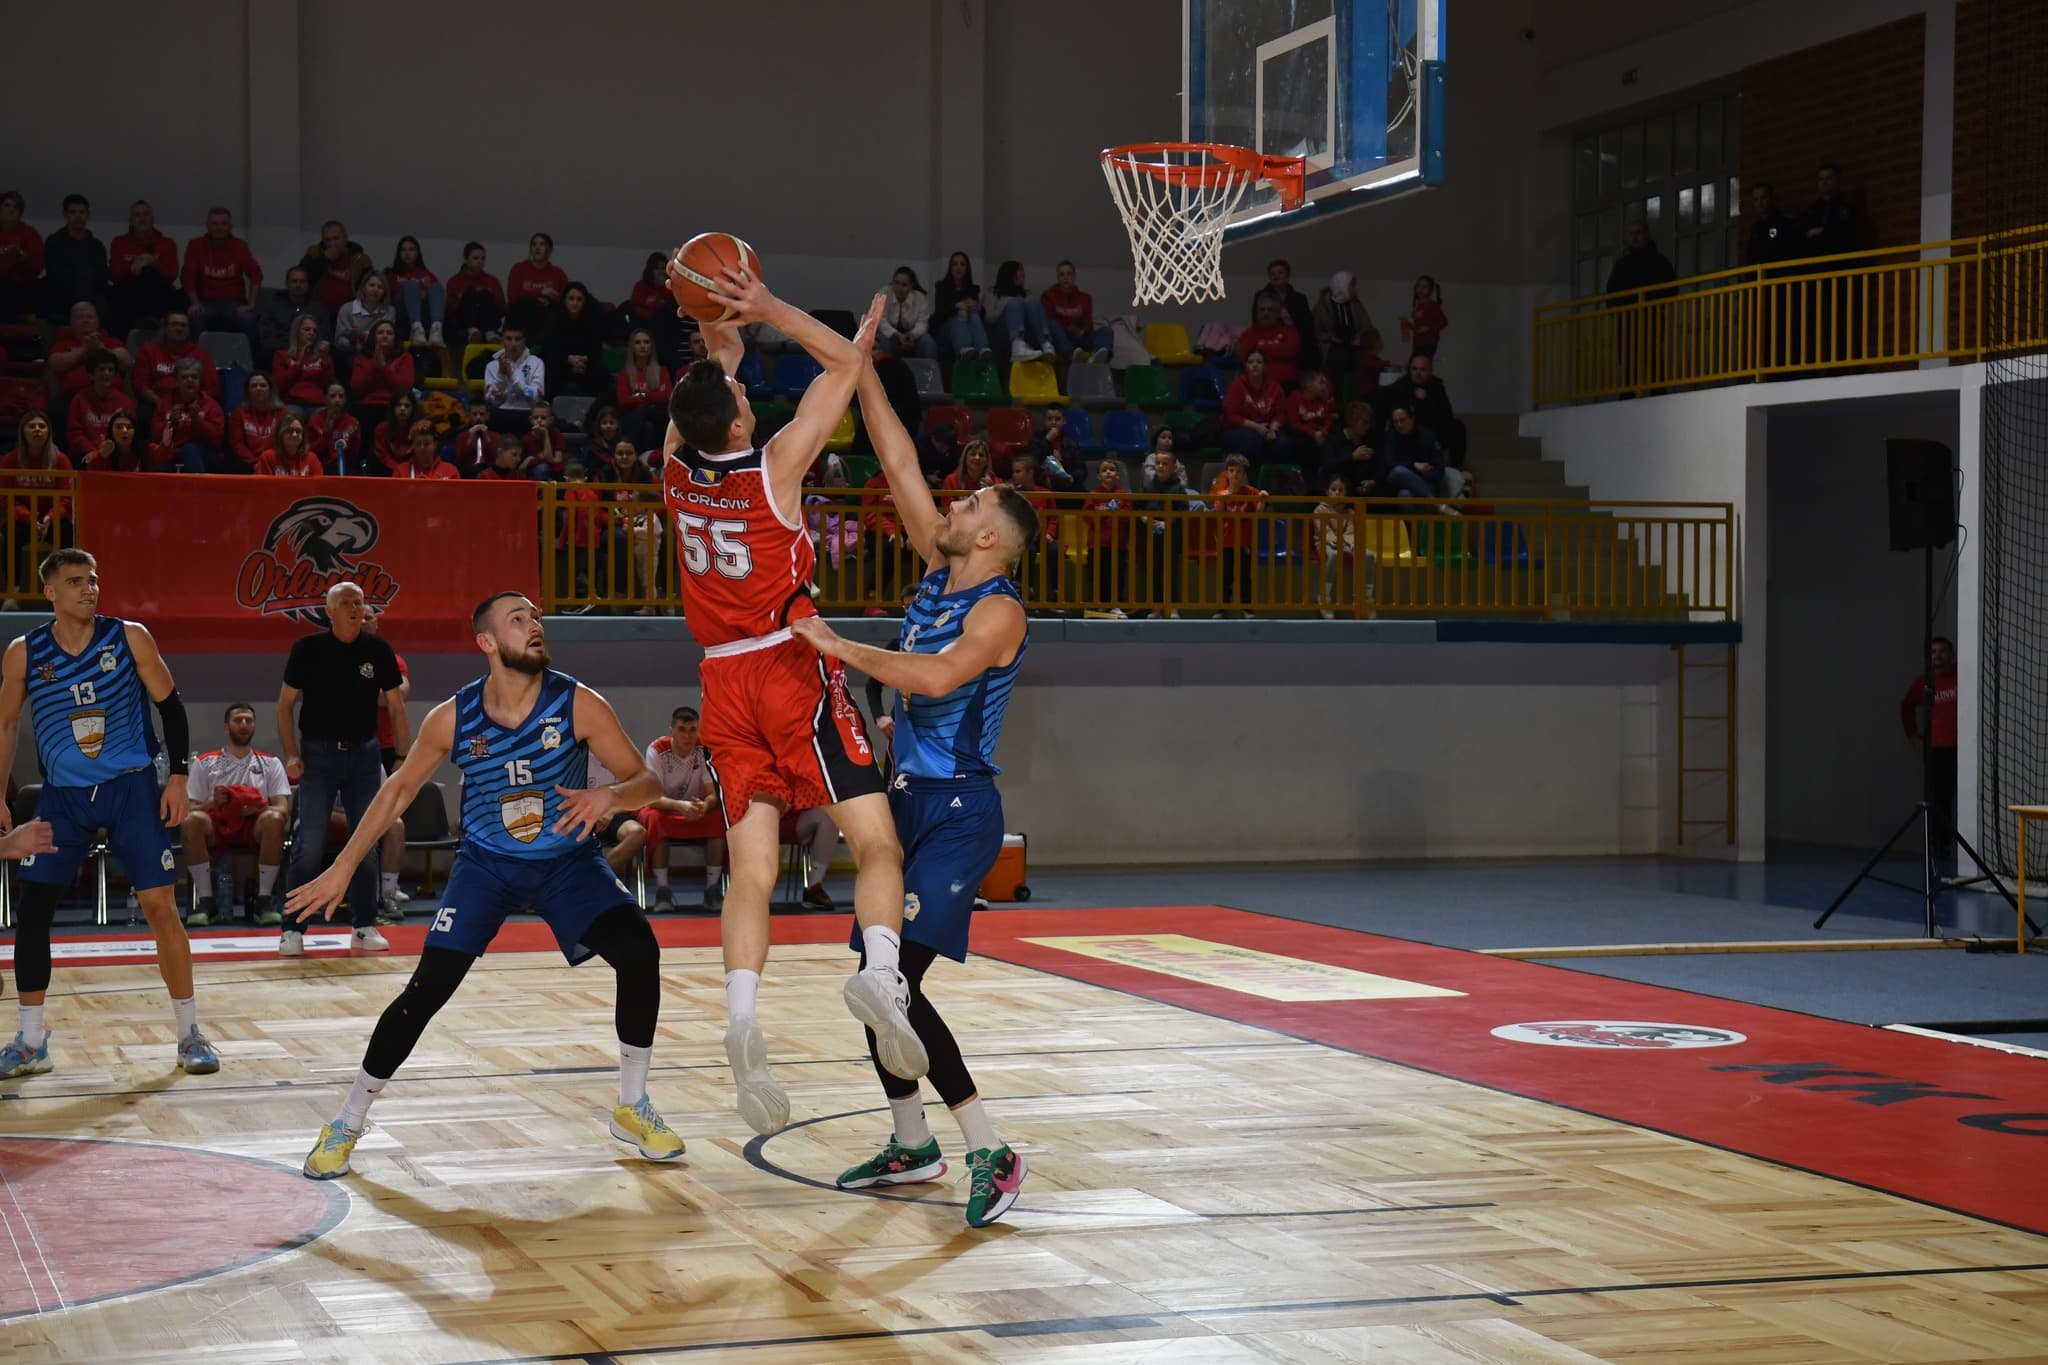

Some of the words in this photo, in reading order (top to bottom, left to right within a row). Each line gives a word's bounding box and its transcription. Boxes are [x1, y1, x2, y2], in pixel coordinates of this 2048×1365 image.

[670, 485, 686, 499] KK
[688, 492, 750, 510] ORLOVIK
[676, 510, 753, 580] 55
[69, 681, 97, 706] 13
[504, 759, 534, 787] 15
[430, 907, 457, 933] 15
